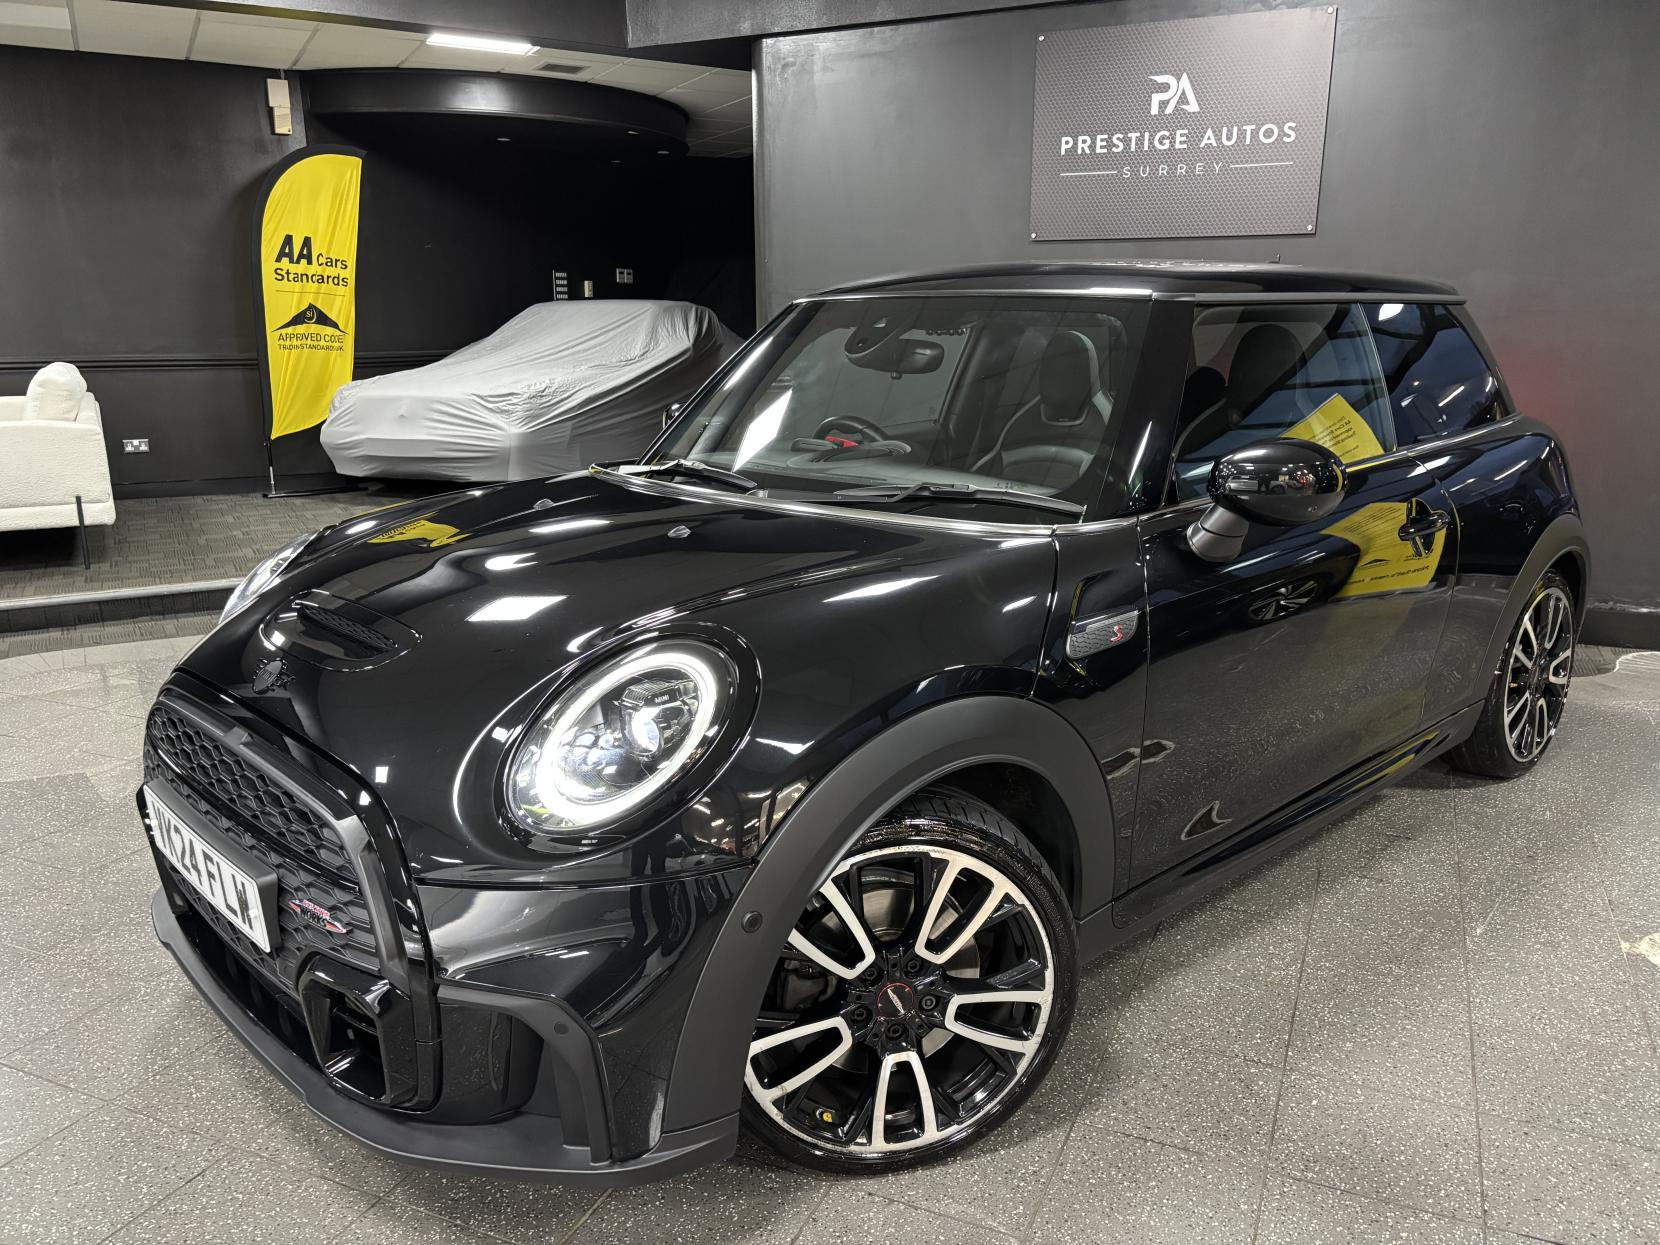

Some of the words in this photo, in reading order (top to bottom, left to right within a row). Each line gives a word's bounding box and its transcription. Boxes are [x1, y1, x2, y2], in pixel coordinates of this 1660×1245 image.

[1148, 72, 1200, 115] PA
[1060, 129, 1188, 156] PRESTIGE
[1200, 122, 1297, 147] AUTOS
[1122, 161, 1223, 178] SURREY
[275, 234, 313, 265] AA
[317, 253, 348, 270] Cars
[152, 800, 202, 886] VK24
[202, 848, 253, 930] FLW
